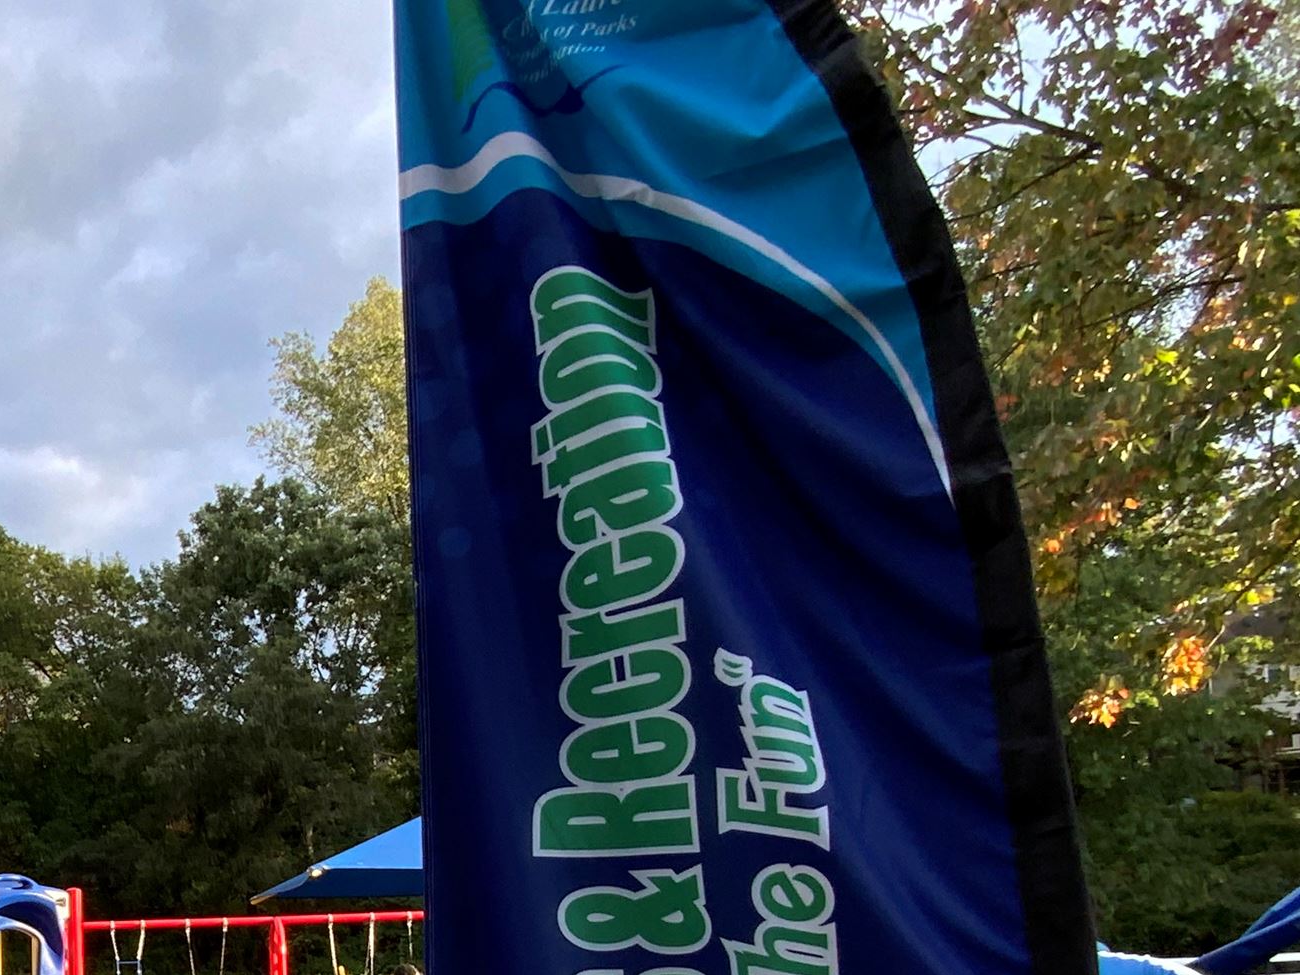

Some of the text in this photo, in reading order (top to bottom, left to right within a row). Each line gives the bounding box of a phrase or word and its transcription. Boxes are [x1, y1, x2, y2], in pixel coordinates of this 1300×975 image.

[553, 24, 577, 40] of
[580, 14, 638, 36] Parks
[530, 265, 699, 857] Recreation
[557, 864, 712, 955] &
